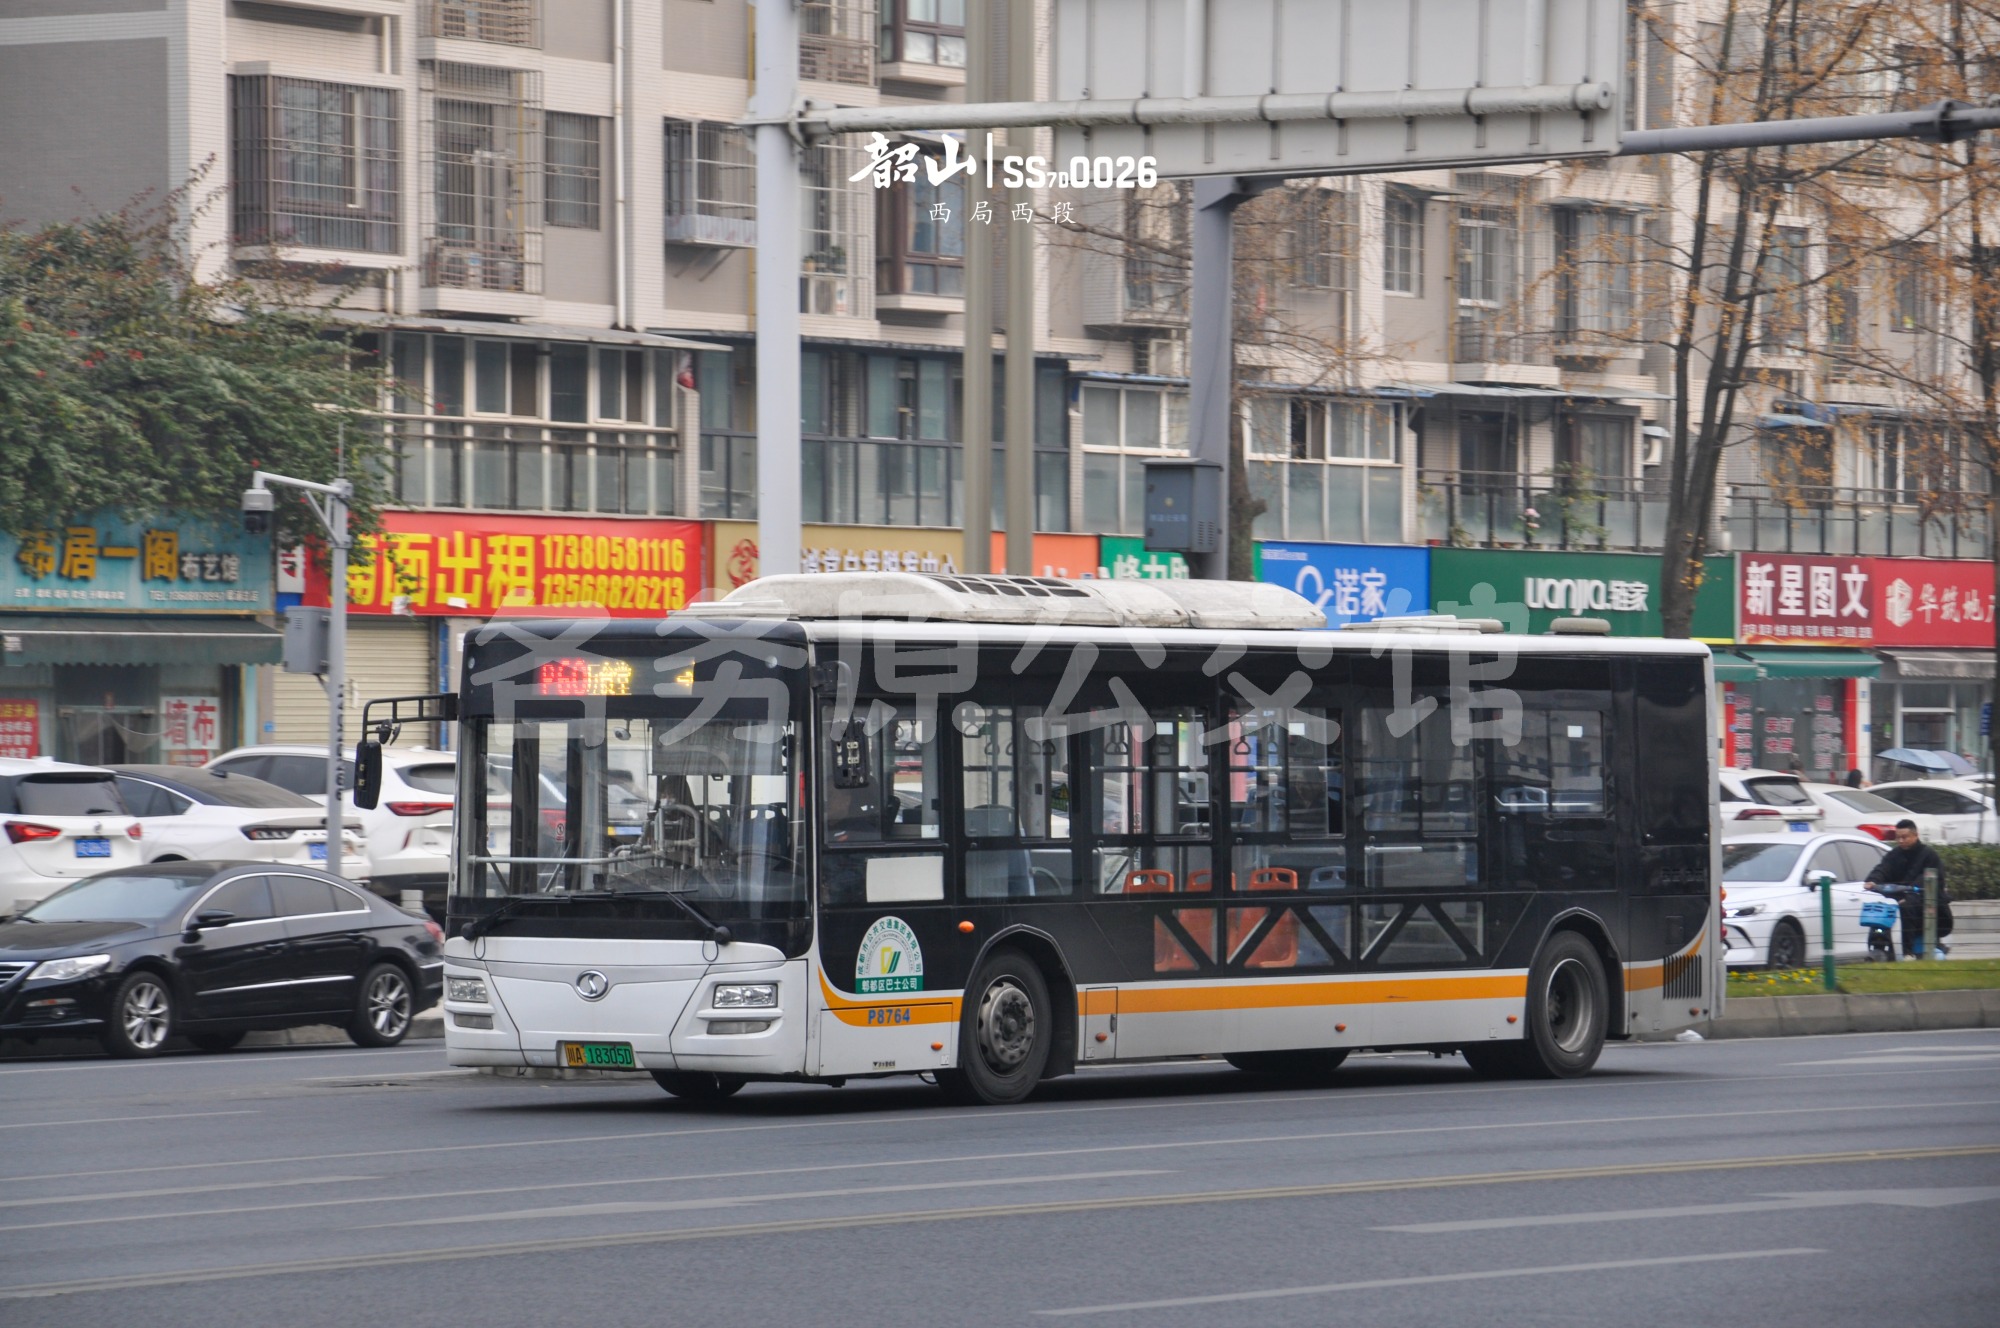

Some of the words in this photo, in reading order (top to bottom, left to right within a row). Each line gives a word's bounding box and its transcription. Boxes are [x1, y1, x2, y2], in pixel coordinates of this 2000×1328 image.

[180, 552, 241, 581] 布艺馆
[541, 534, 686, 572] 17380581116
[541, 573, 686, 610] 13568826213
[1745, 560, 1870, 618] 新星图文
[163, 699, 218, 747] 墙布
[862, 977, 918, 993] 郫都区巴士公司
[868, 1007, 911, 1025] P8764
